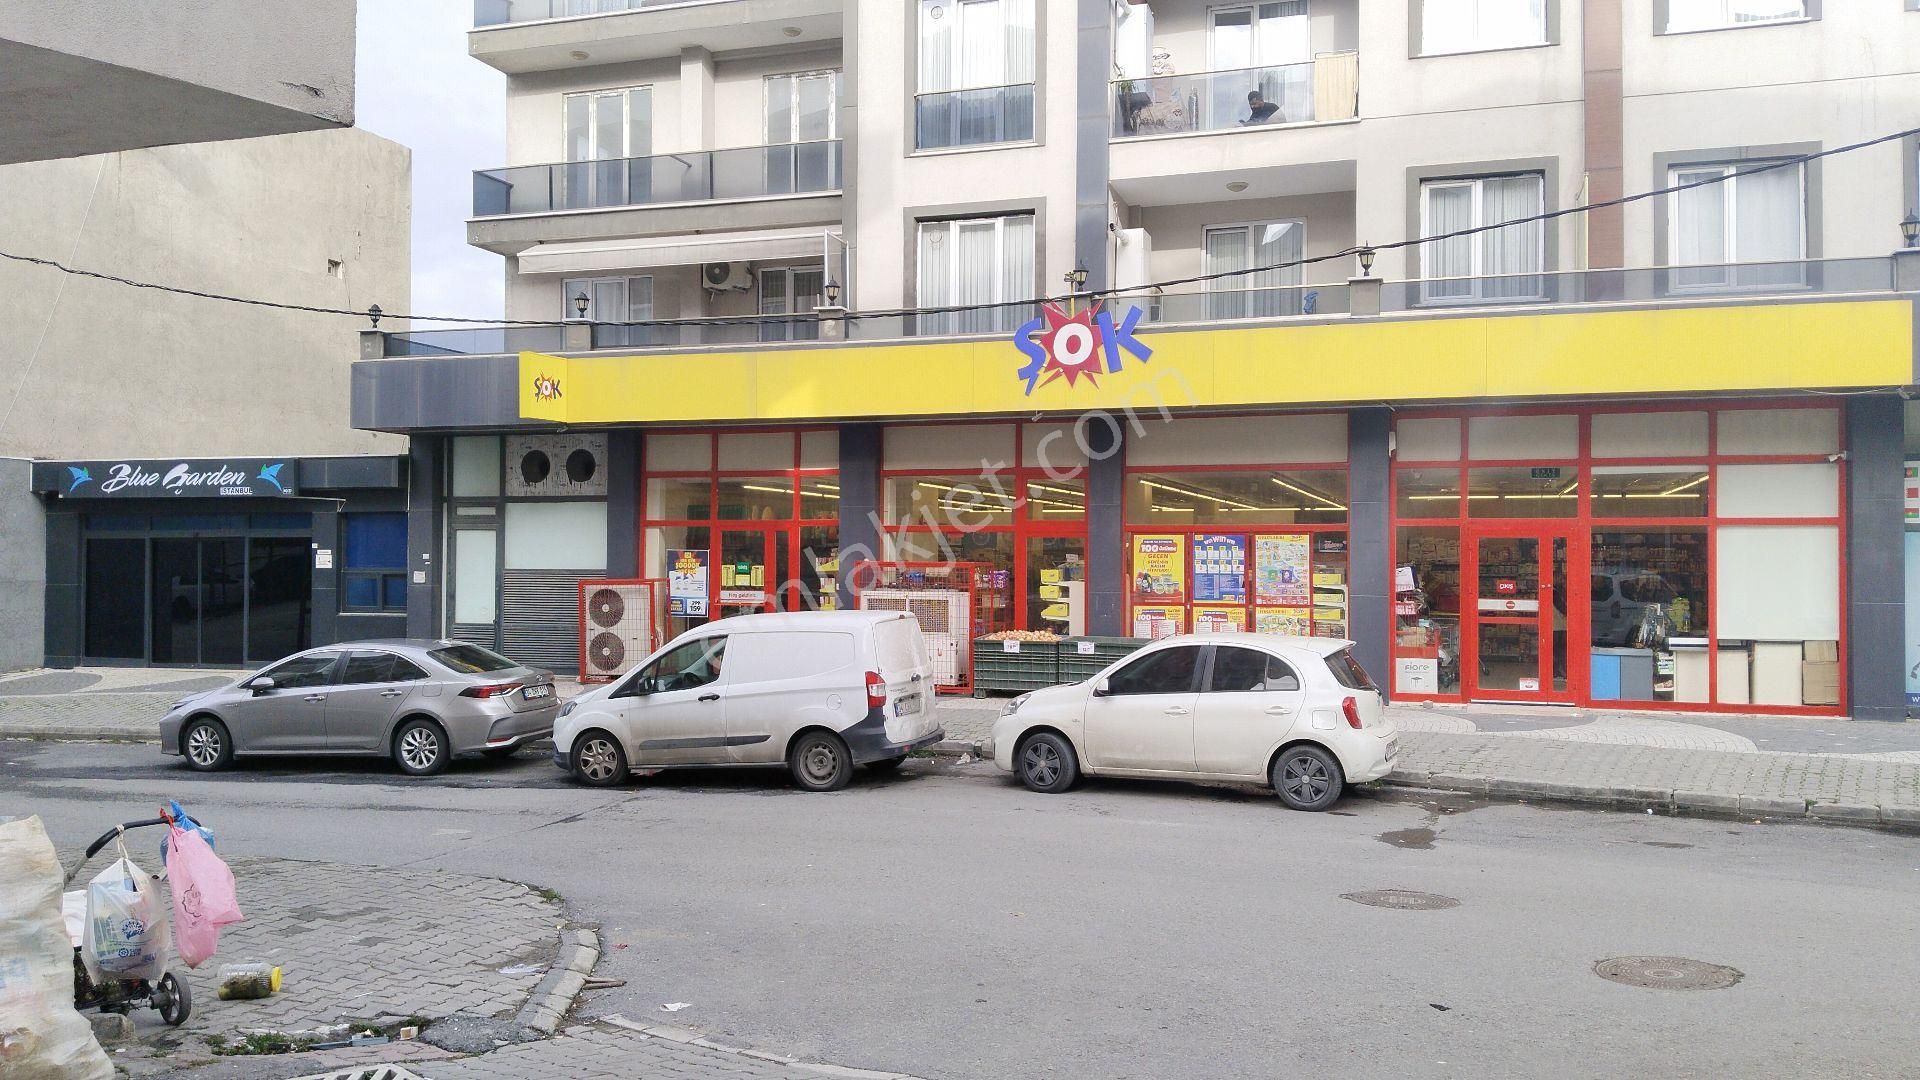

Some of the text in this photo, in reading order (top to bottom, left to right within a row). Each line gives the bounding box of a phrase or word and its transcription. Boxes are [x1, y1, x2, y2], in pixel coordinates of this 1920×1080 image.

[1014, 305, 1153, 396] ŞOK
[534, 377, 562, 402] ŞOK
[101, 463, 246, 494] Blue Garden
[1141, 544, 1158, 552] 100
